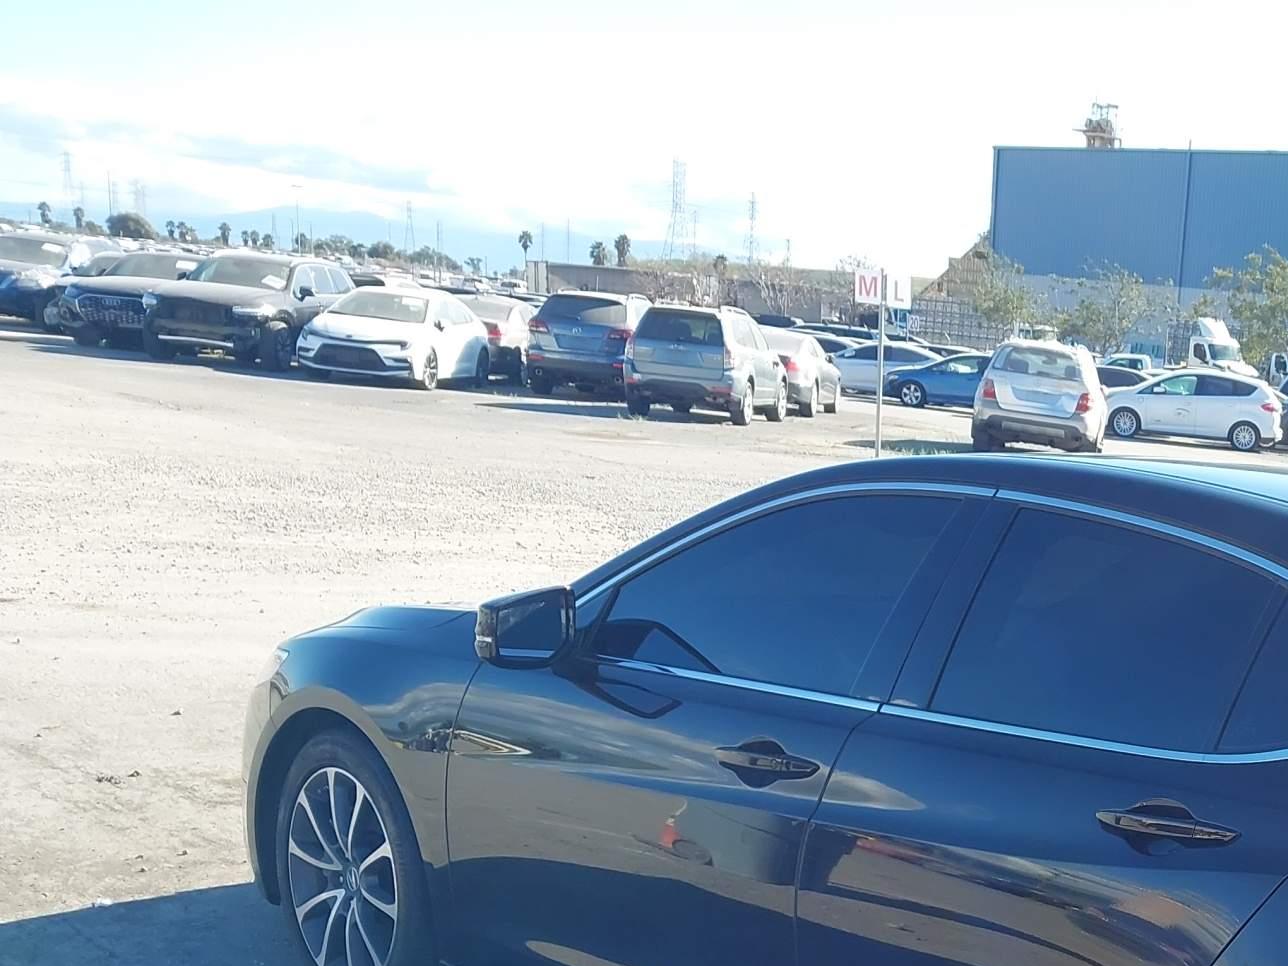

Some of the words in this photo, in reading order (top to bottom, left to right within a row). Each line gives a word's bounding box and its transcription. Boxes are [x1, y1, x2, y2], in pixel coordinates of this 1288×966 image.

[859, 275, 878, 297] M
[895, 280, 905, 302] L
[910, 317, 919, 329] 20
